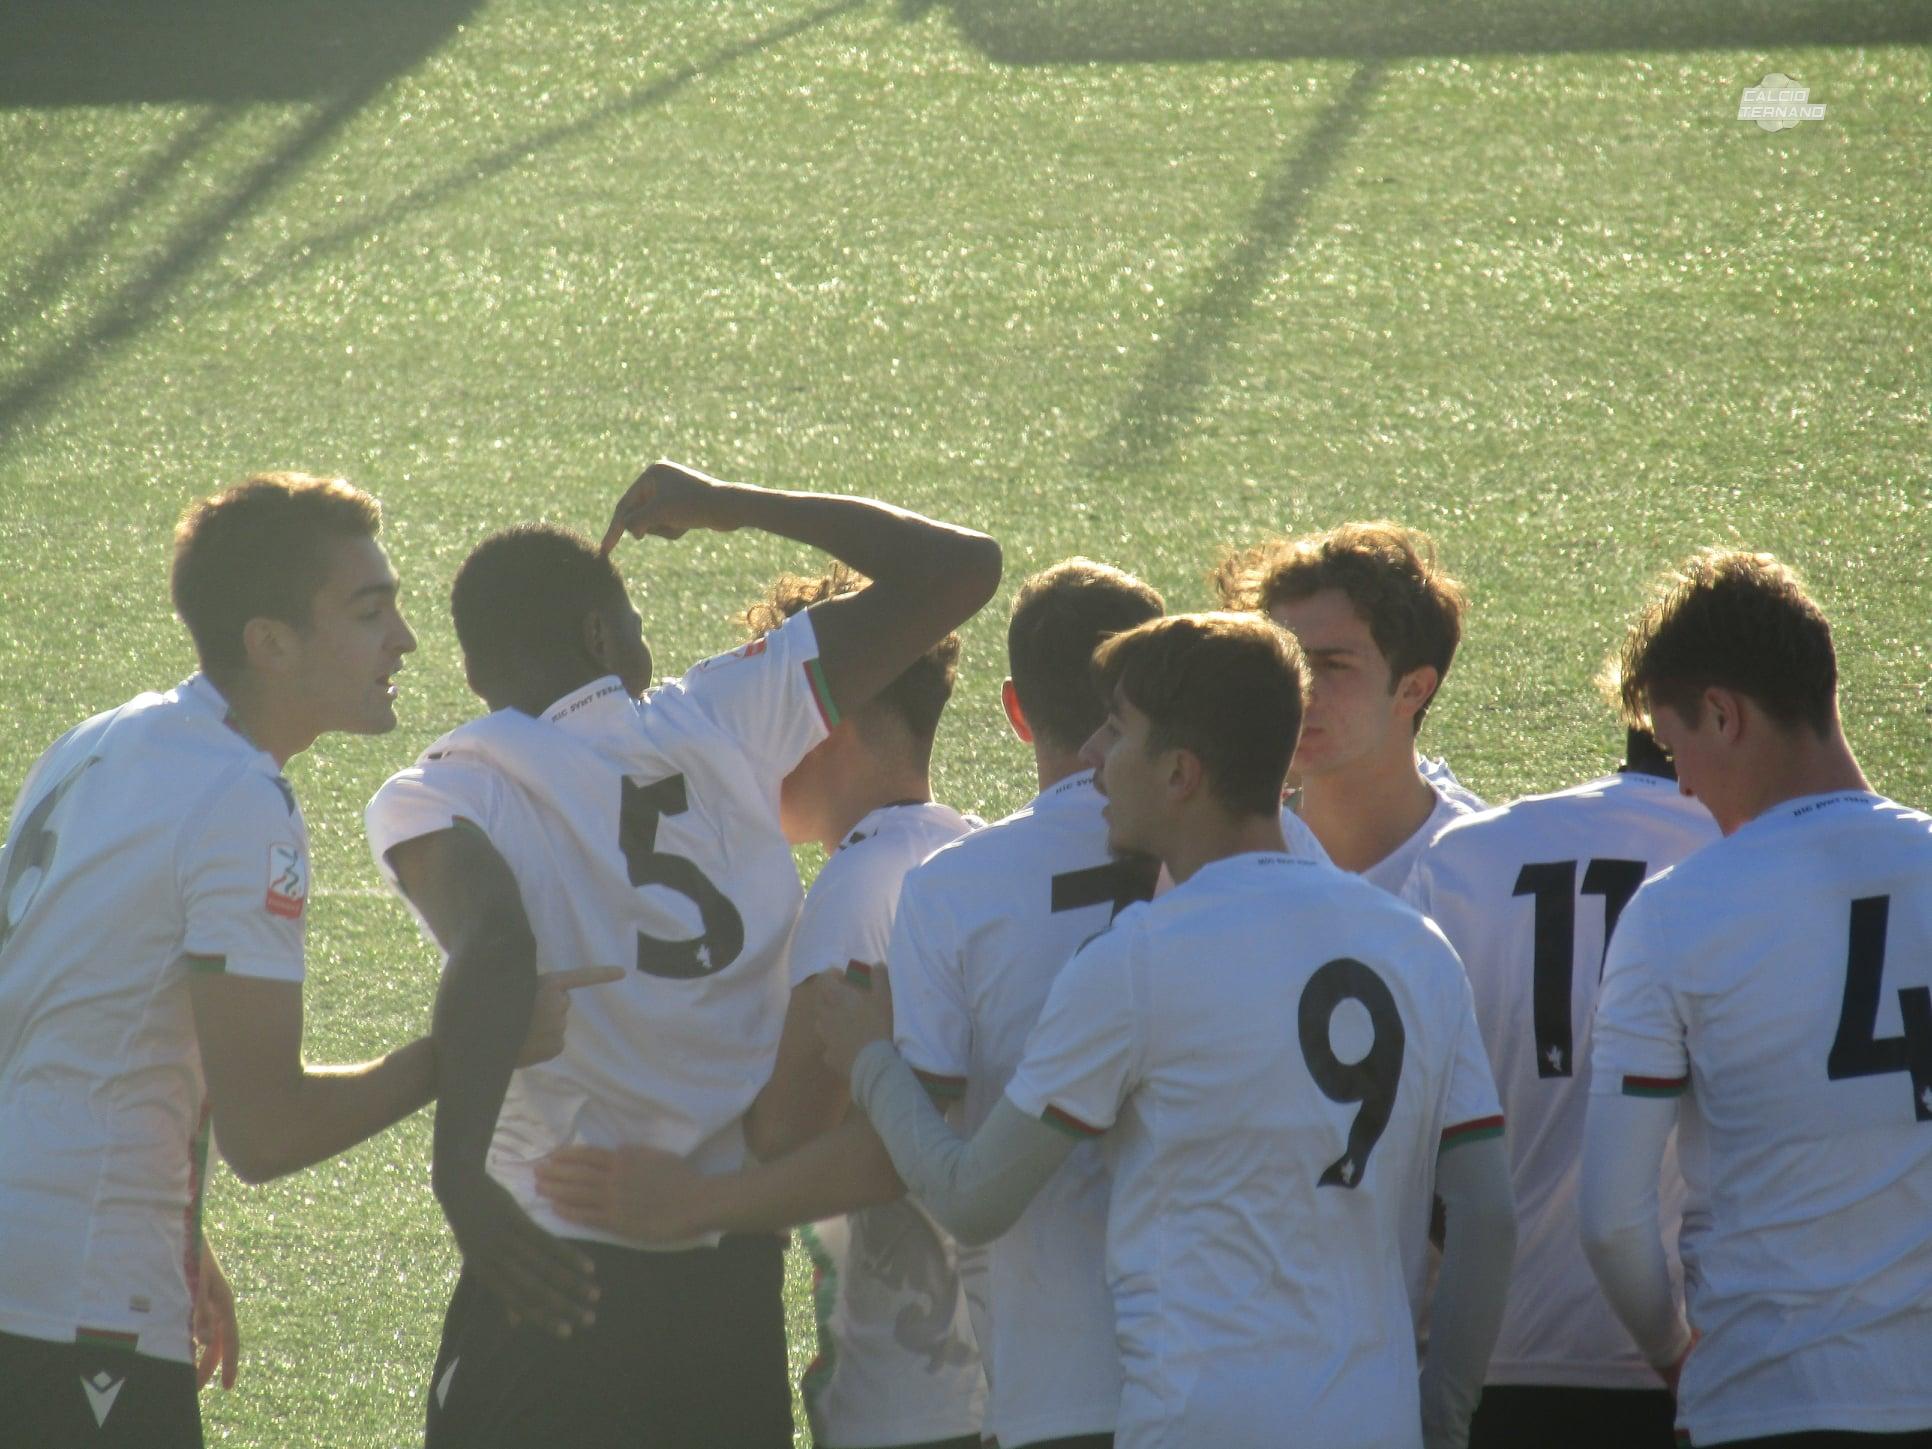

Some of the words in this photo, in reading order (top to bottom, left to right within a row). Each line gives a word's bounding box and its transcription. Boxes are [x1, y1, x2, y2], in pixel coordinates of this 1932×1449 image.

[620, 773, 744, 979] 5
[1298, 958, 1405, 1190] 9
[1827, 895, 1932, 1122] 4
